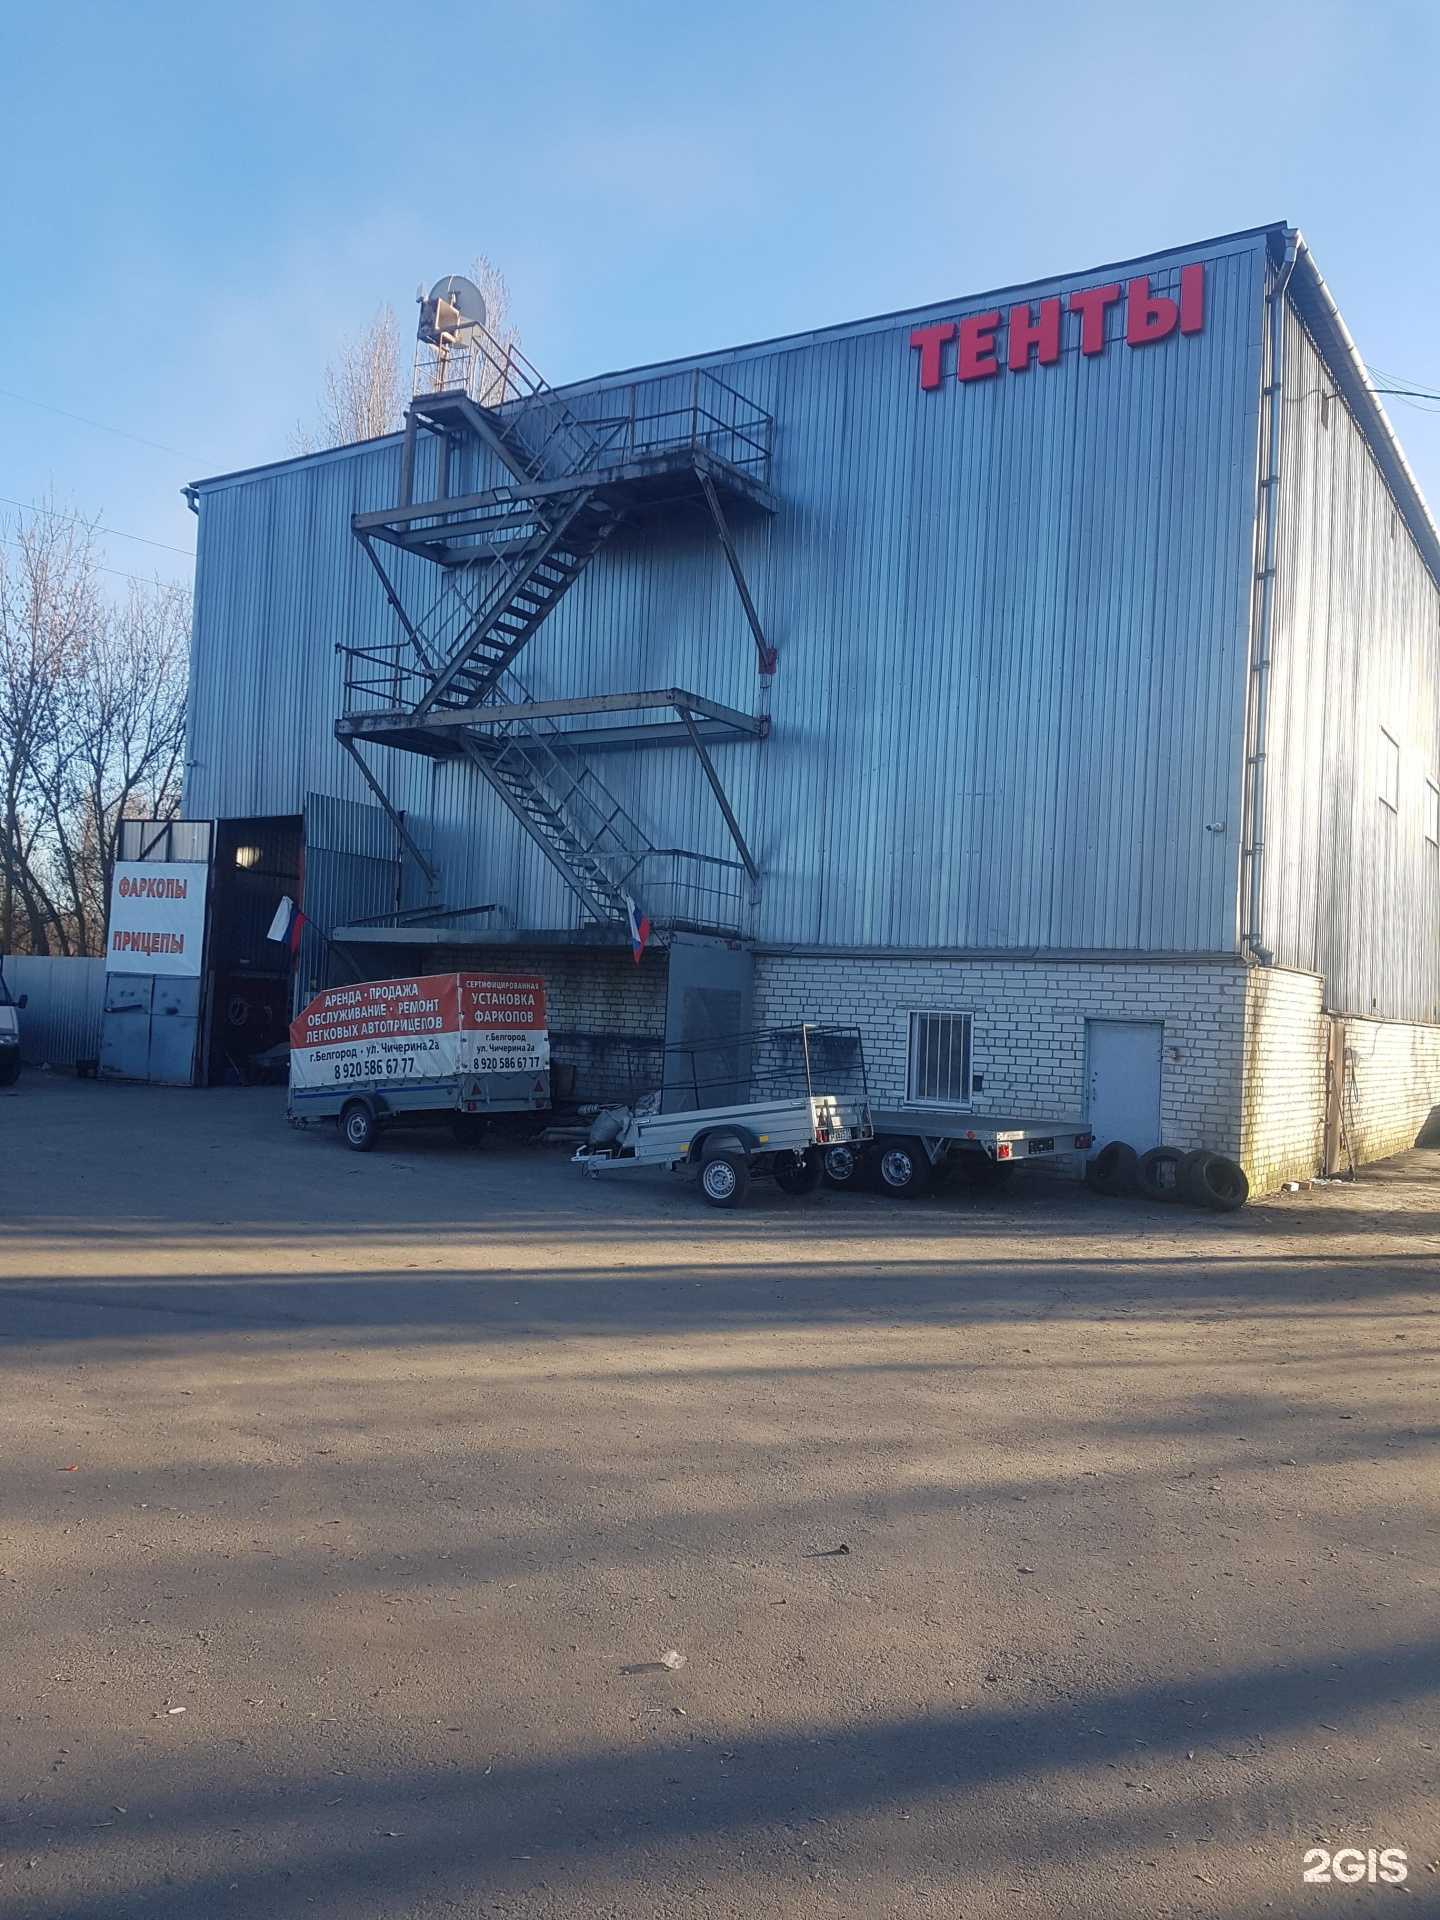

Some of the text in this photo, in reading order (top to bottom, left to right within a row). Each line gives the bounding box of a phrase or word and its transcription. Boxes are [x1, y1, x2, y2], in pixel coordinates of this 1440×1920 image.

[909, 262, 1205, 391] ТЕНТЫ
[118, 876, 187, 899] ФАРКОПЫ
[112, 931, 184, 956] ПРИЦЕПЫ
[324, 983, 419, 1008] АРЕНДА ПРОДАЖА
[466, 980, 539, 990] СЕРТИФИЦИРОВАННАЯ
[471, 992, 535, 1006] УСТАНОВКА
[307, 999, 439, 1027] ОБСЛУЖИВАНИЕ РЕМОНТ
[474, 1009, 534, 1023] ФАРКОПОВ
[306, 1016, 443, 1043] ЛЕГКОВЫХ АВТОПРИЦЕПОВ
[366, 1045, 379, 1057] ул.
[381, 1040, 427, 1055] Чичерина
[428, 1039, 439, 1050] 2а
[476, 1043, 535, 1054] ул. Чичерина 2а
[334, 1057, 415, 1080] 8 920 586 67 77
[473, 1056, 540, 1070] 8 920 586 67 77
